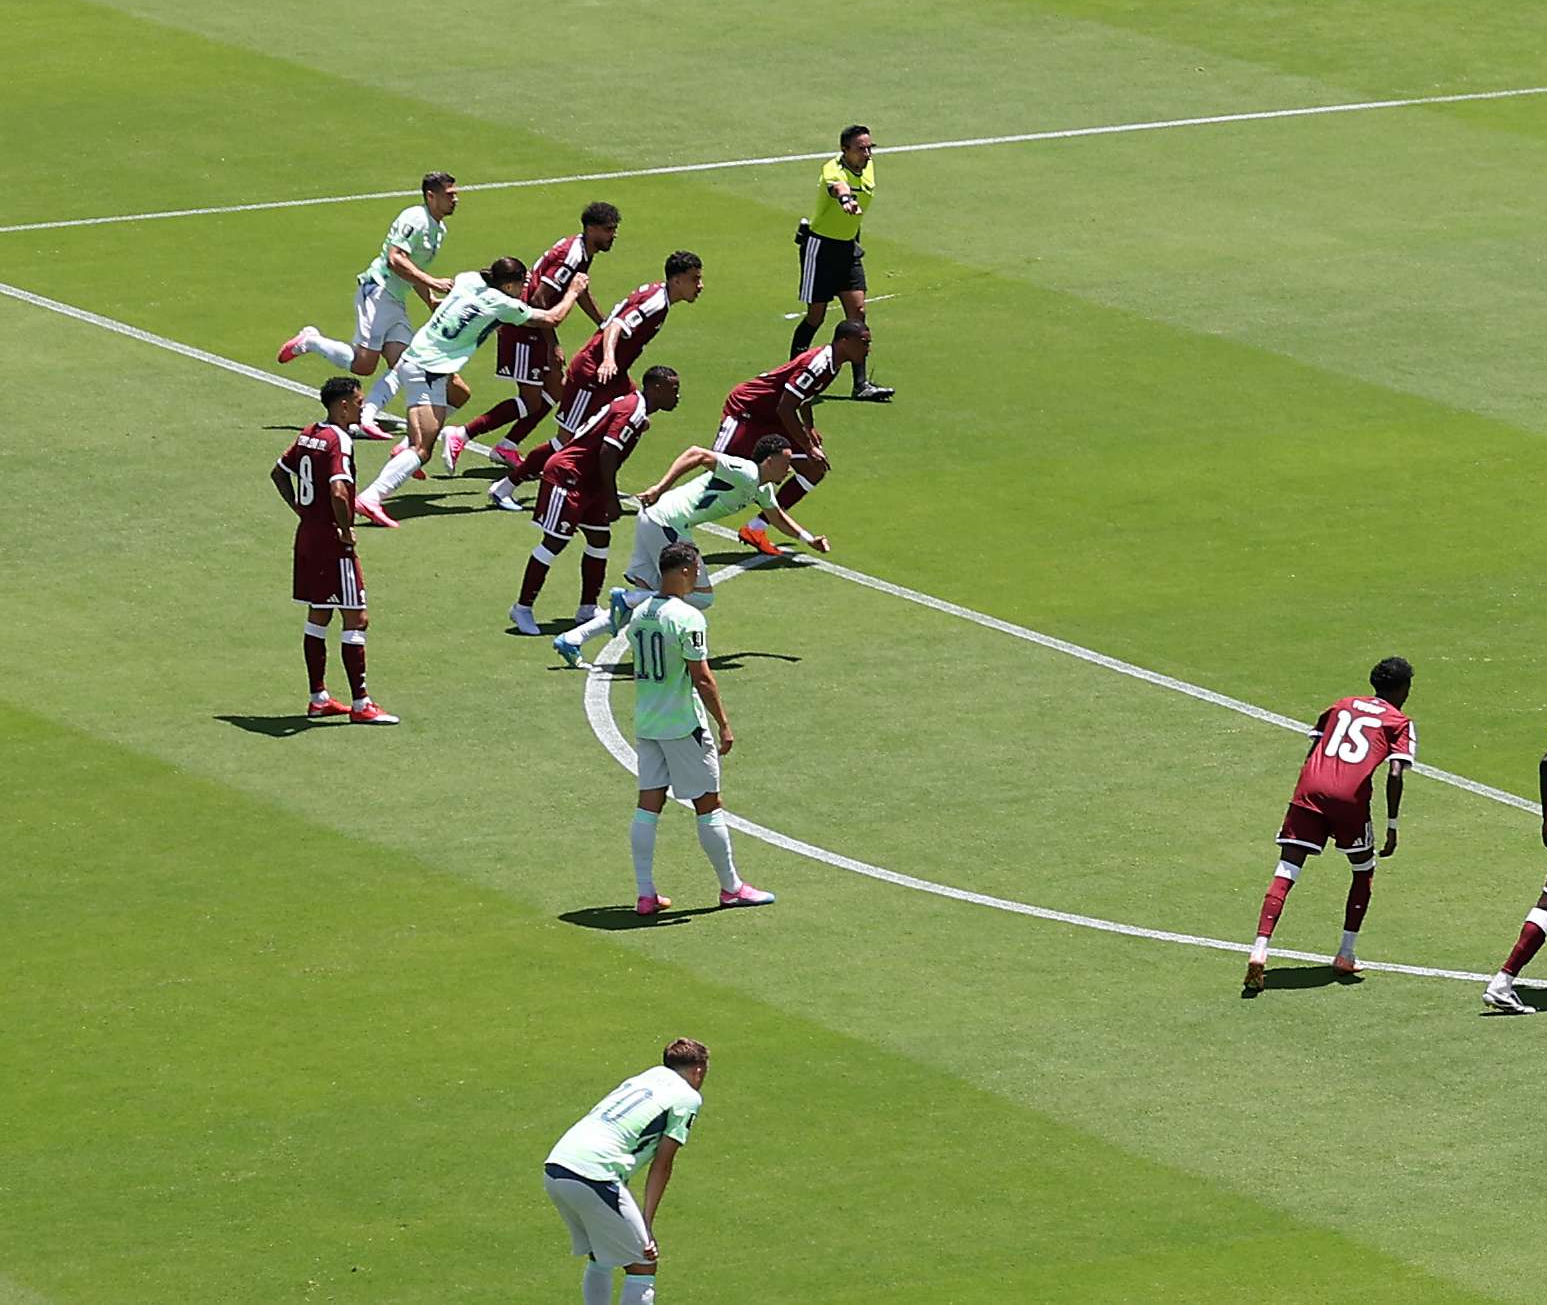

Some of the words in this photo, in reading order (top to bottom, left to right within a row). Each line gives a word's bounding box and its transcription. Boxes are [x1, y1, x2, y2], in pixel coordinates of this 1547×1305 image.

[299, 454, 315, 506] 8
[633, 628, 665, 682] 10
[1324, 709, 1383, 764] 15
